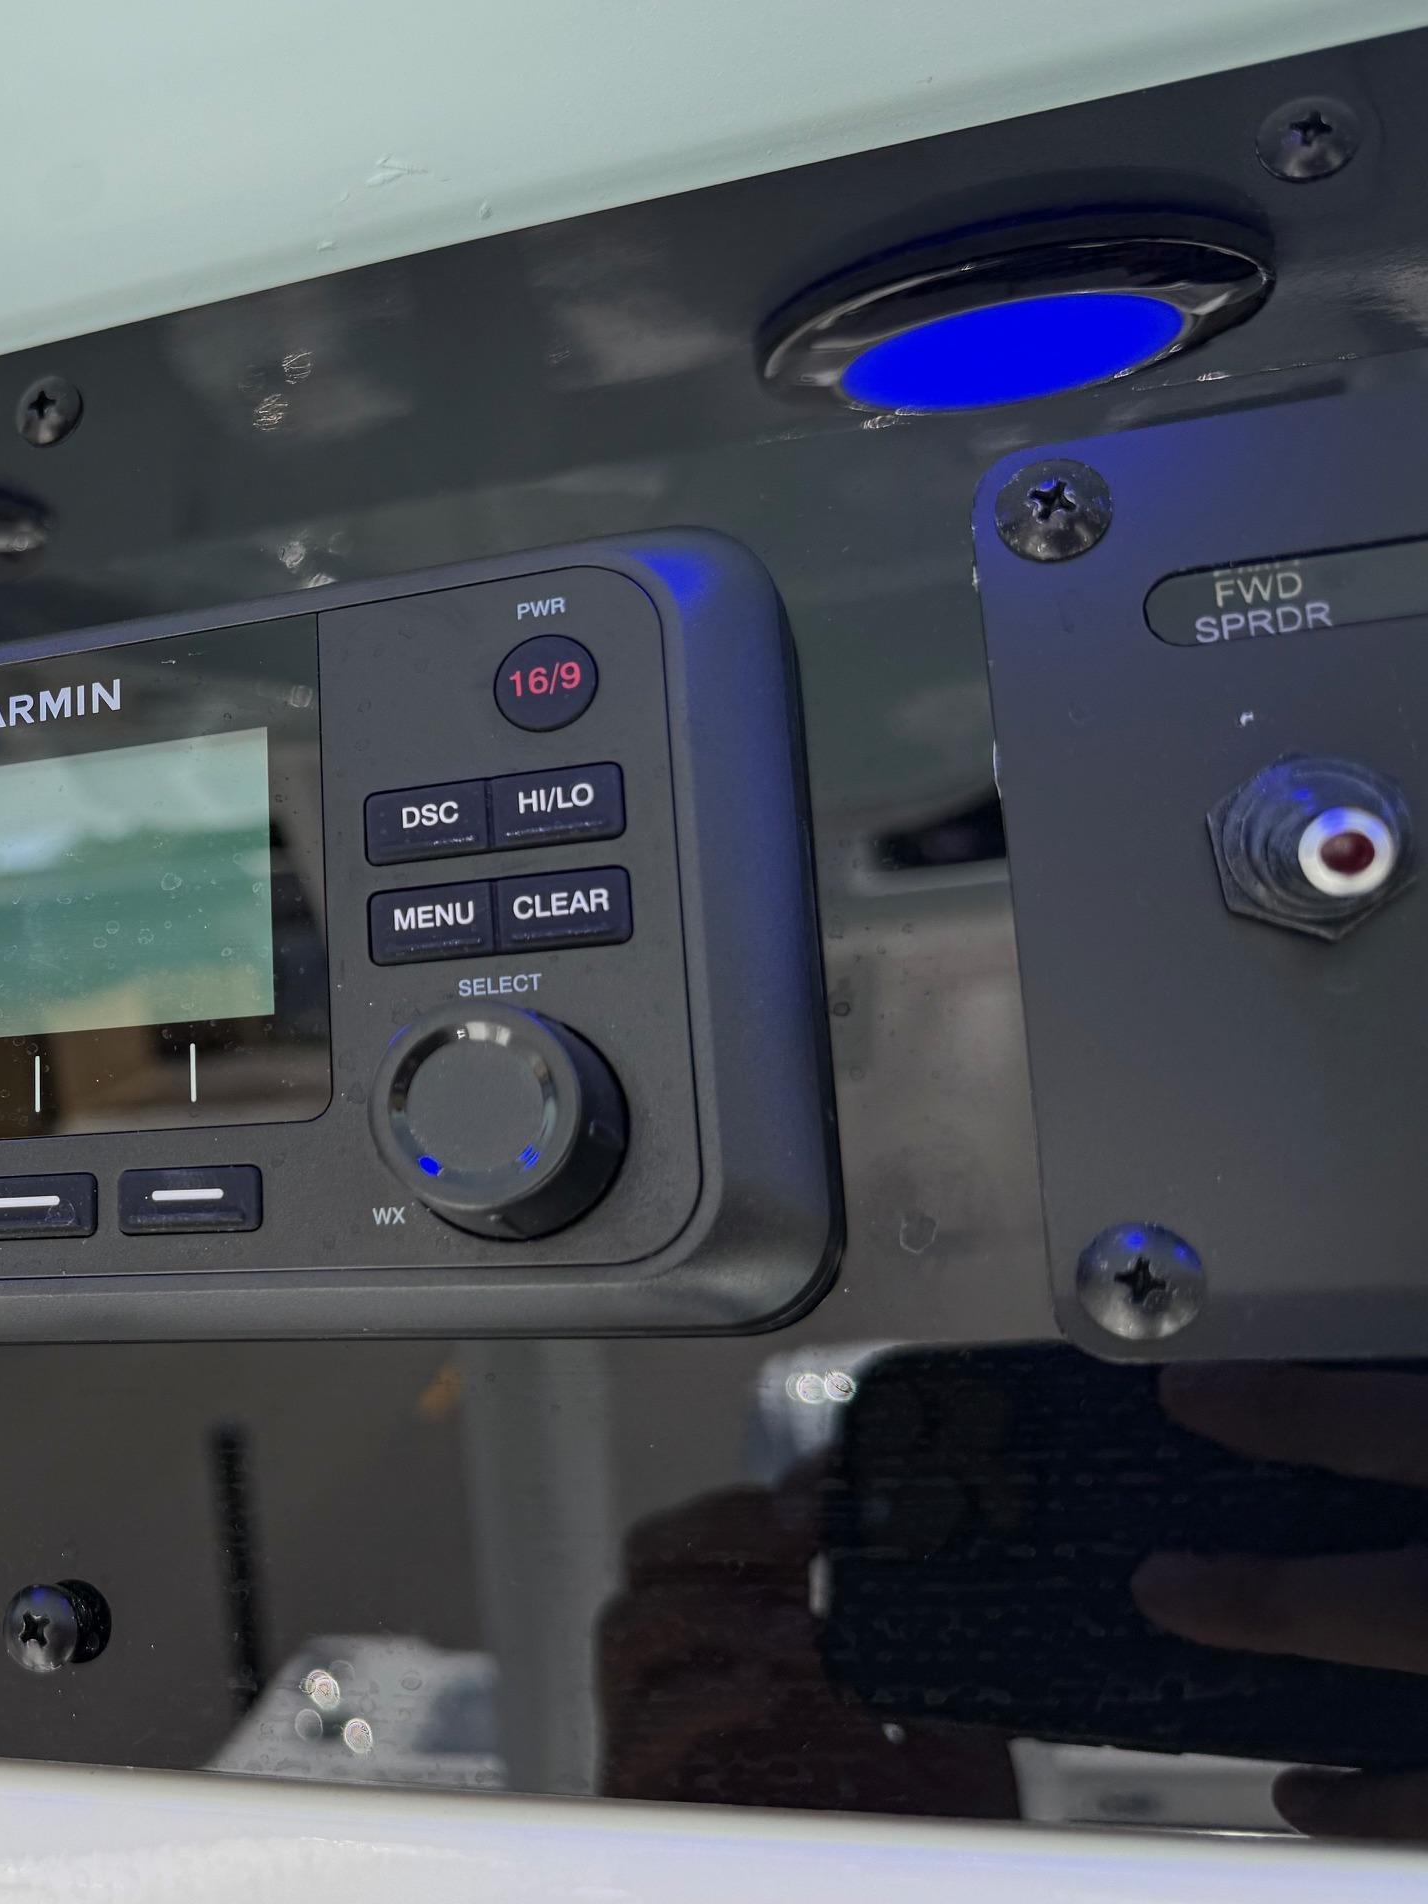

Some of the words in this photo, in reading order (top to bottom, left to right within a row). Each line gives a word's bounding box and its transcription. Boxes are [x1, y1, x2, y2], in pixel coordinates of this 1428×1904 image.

[1215, 572, 1303, 608] FWD
[517, 597, 566, 620] PWR
[1195, 602, 1333, 643] SPRDR
[509, 661, 582, 698] 16/9
[518, 783, 595, 814] HI/LO
[401, 801, 460, 829] DSC
[393, 901, 475, 931] MENU
[513, 888, 610, 920] CLEAR
[458, 974, 542, 997] SELECT
[373, 1206, 406, 1225] WX
